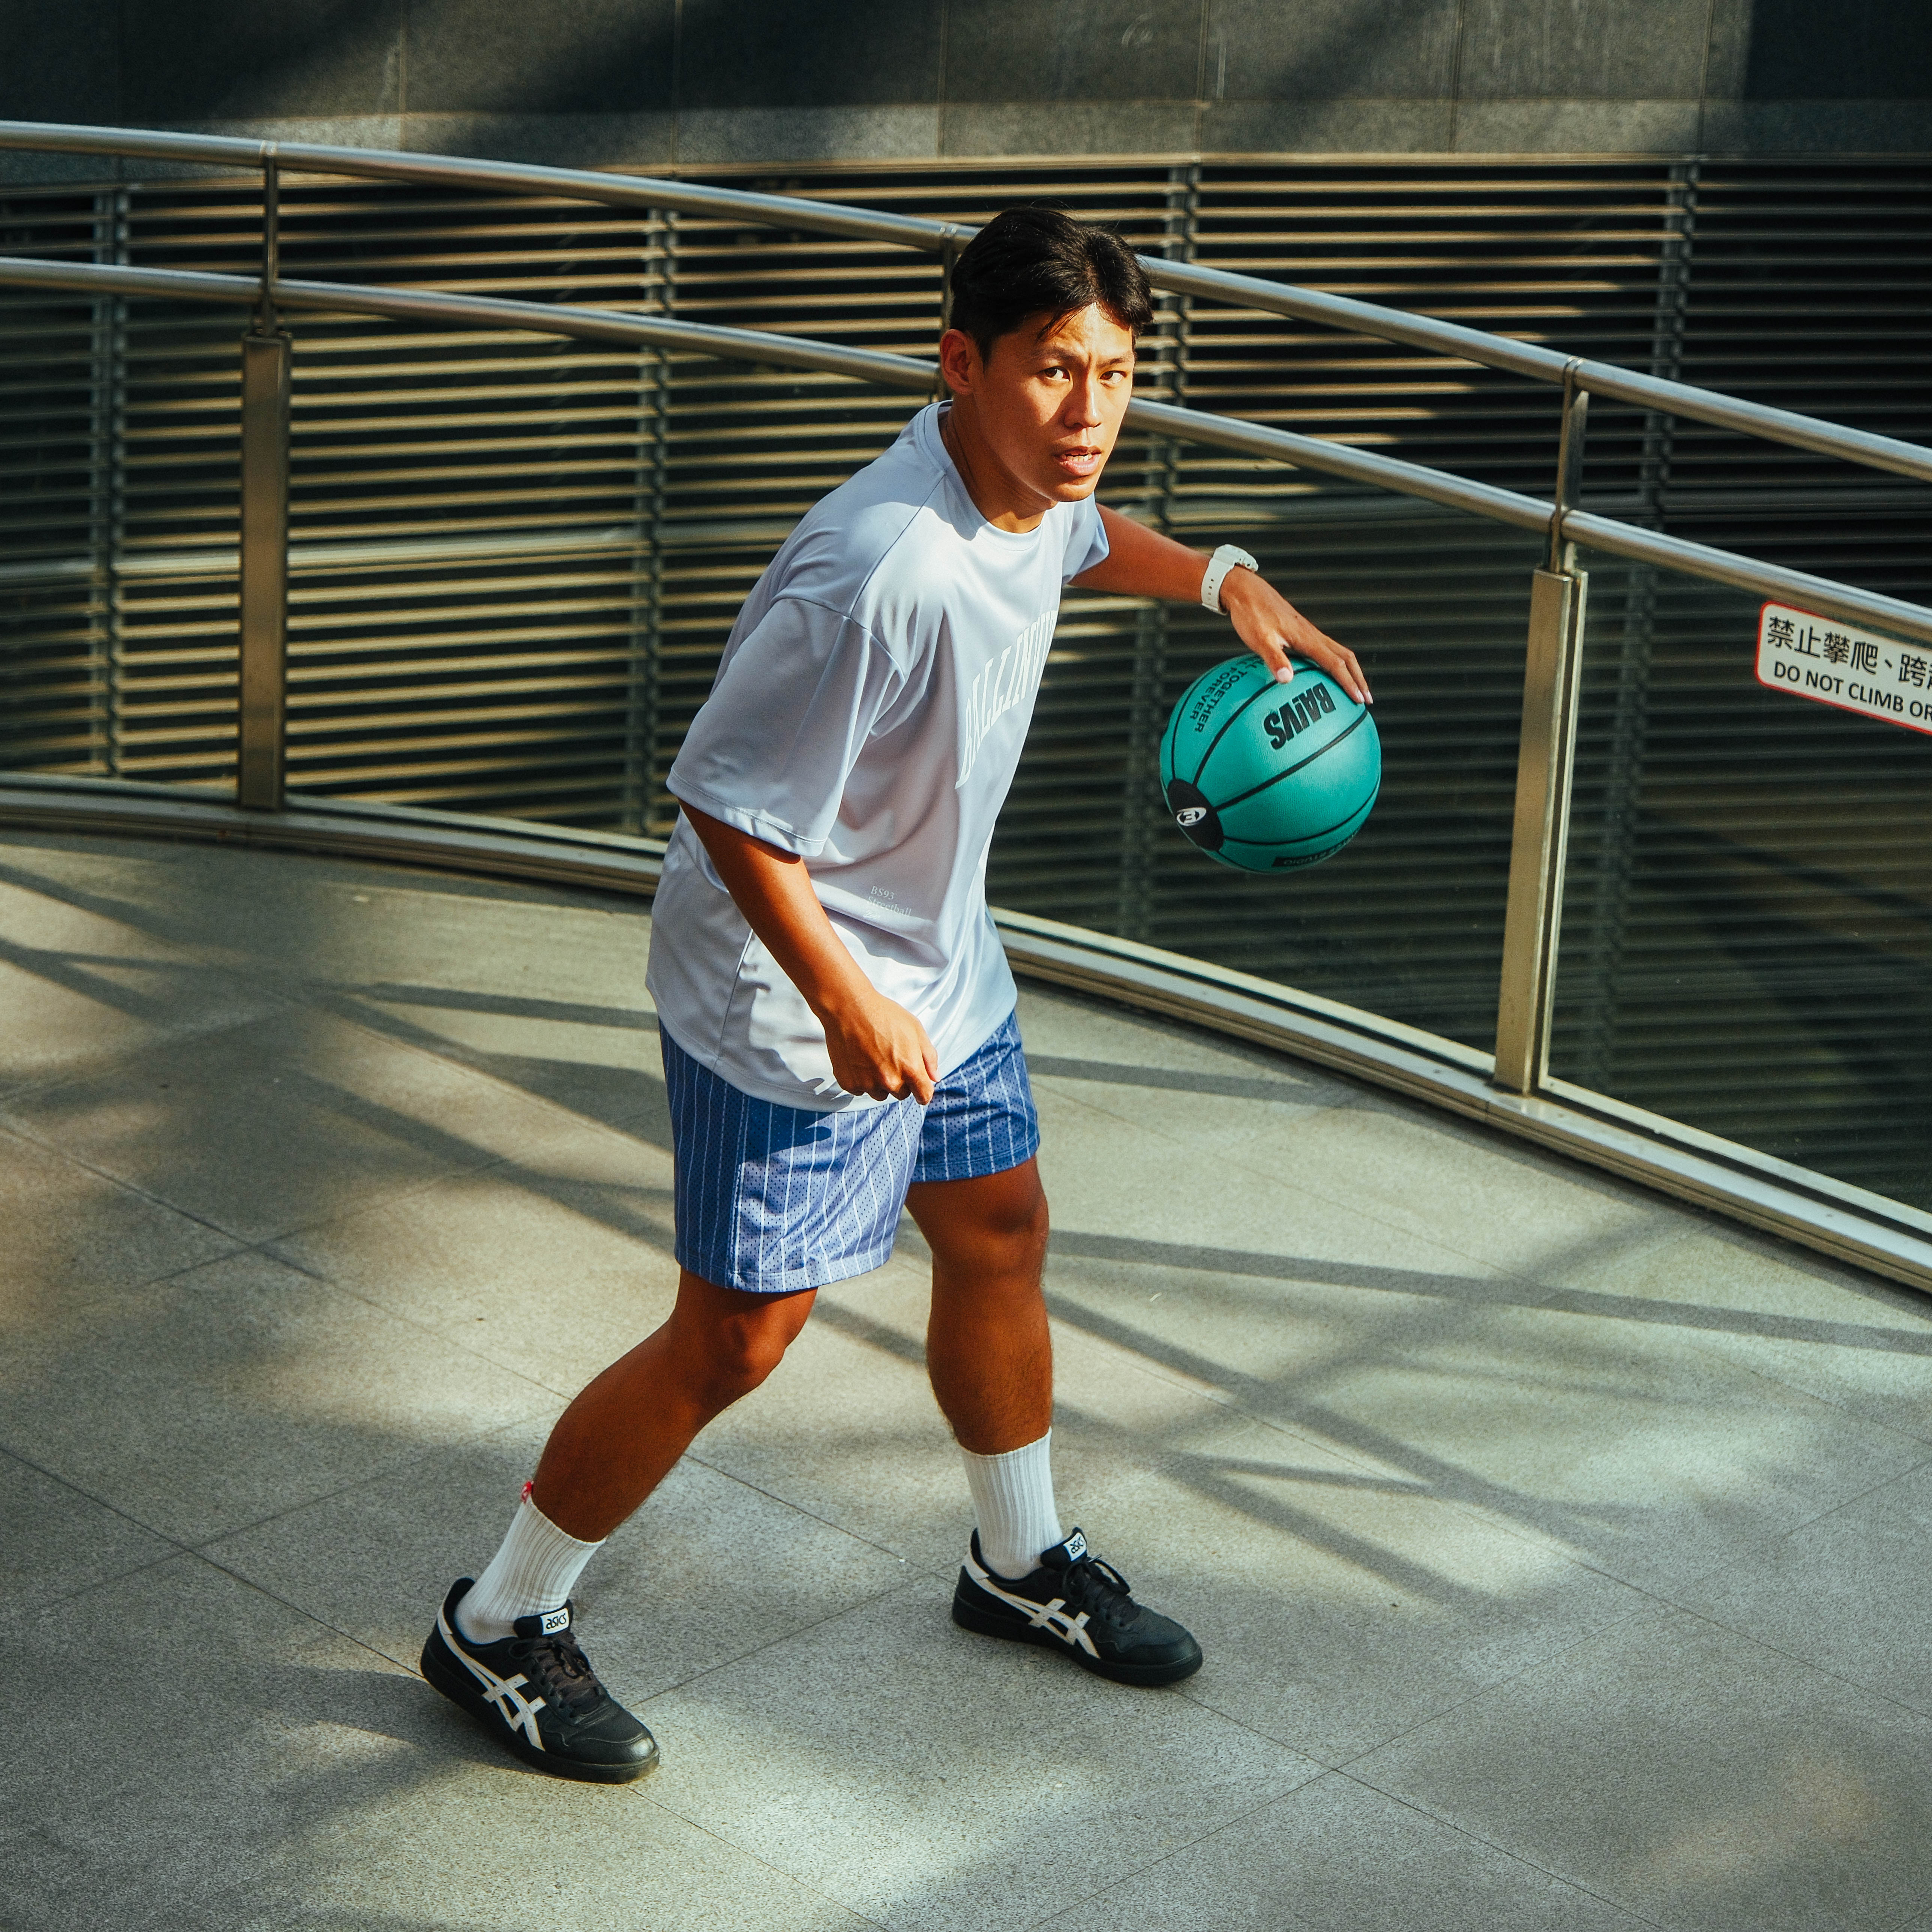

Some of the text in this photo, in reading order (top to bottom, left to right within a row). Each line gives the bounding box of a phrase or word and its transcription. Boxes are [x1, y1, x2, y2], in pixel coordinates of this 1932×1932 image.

[1190, 667, 1238, 720] FOREVER
[1195, 671, 1248, 732] TOGETHER
[1774, 661, 1932, 722] DO NOT CLIMB OR
[867, 896, 912, 916] Streetball
[870, 886, 895, 900] BS93
